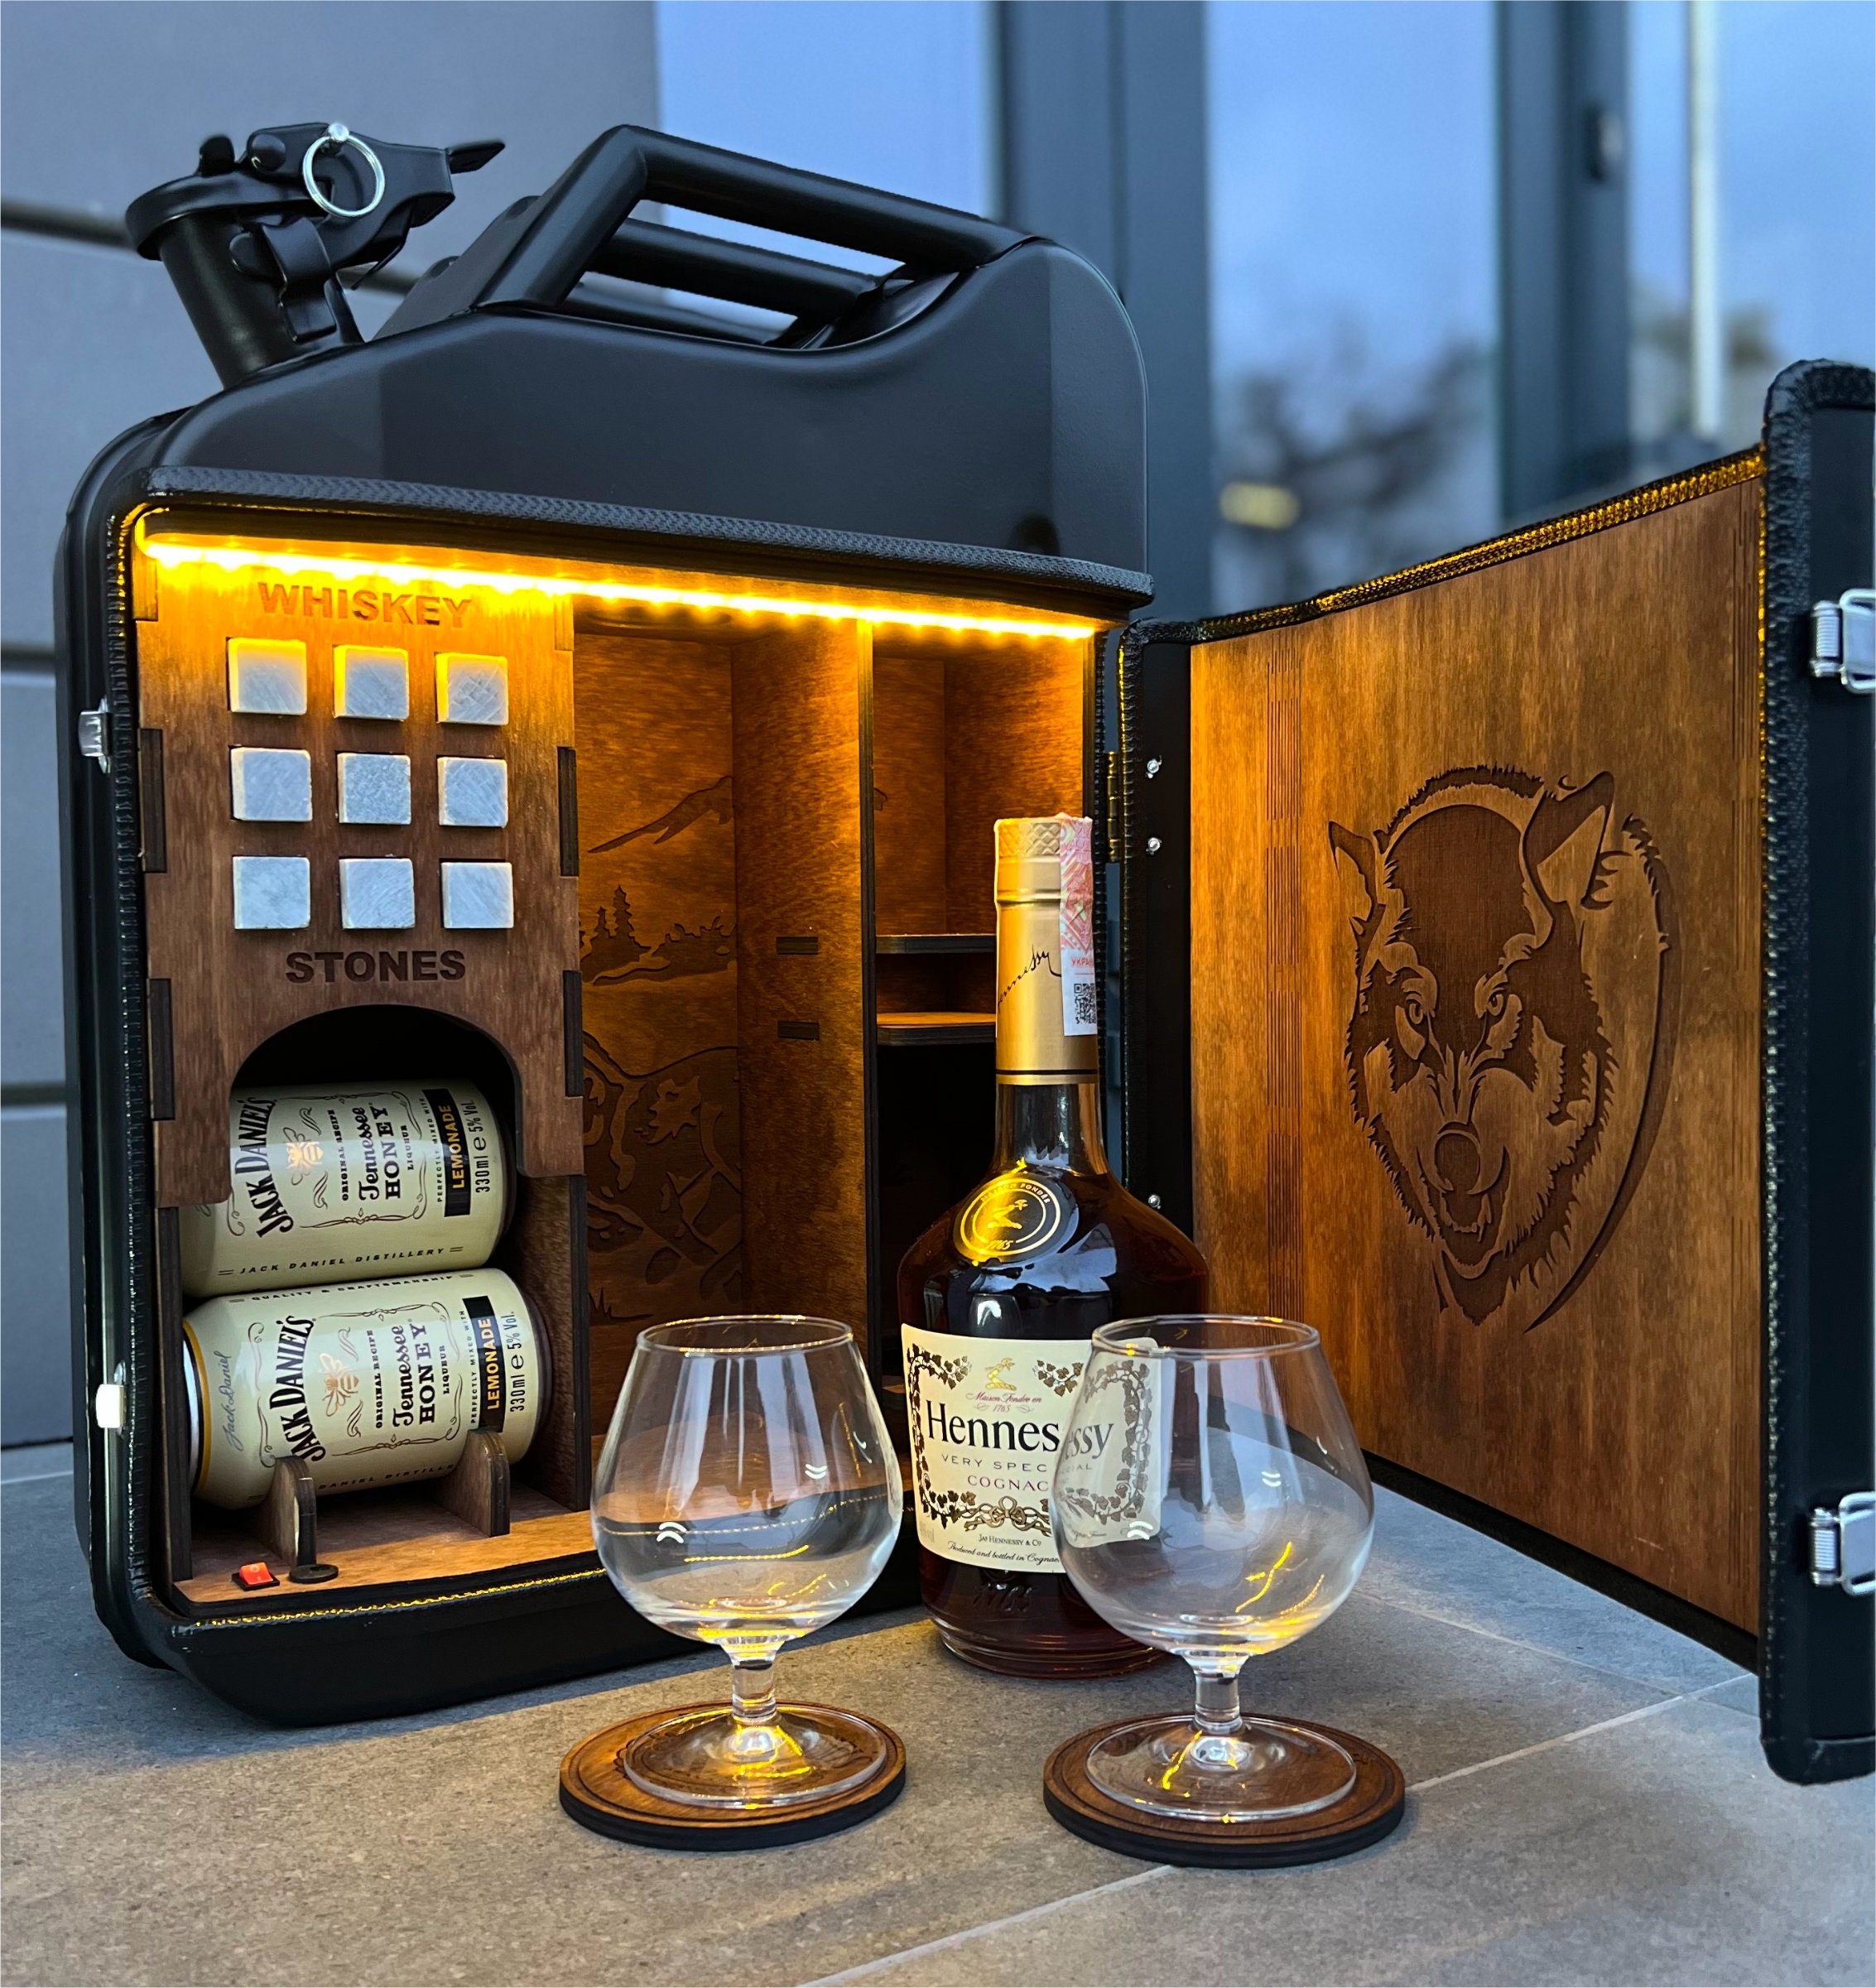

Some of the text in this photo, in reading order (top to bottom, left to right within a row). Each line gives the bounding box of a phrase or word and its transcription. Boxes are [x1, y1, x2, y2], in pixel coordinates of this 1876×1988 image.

[257, 582, 471, 628] WHISKEY
[285, 951, 466, 983] STONES
[427, 1119, 438, 1144] MIXED
[438, 1105, 464, 1189] LEMONADE
[467, 1117, 483, 1133] 5%
[234, 1097, 294, 1238] JACK DANIEL'S
[339, 1147, 349, 1201] ORIGINAL
[352, 1107, 379, 1201] Tennessee
[370, 1106, 401, 1200] HONEY
[474, 1155, 490, 1193] 330ml
[239, 1248, 445, 1274] JACK DANIEL DISTILLERY
[478, 1317, 500, 1410] LEMONADE
[507, 1332, 522, 1350] 5%
[269, 1315, 326, 1461] JACK DANIEL'S
[367, 1330, 383, 1428] ORIGINAL RECIPE
[392, 1325, 414, 1427] Tennessee
[410, 1323, 435, 1424] HONEY
[439, 1345, 450, 1394] LIQUEUR
[459, 1311, 479, 1423] PERFECTLY MIXED WITH
[510, 1374, 526, 1413] 330ml
[993, 1404, 1012, 1413] 1765
[941, 1454, 983, 1467] VERY
[967, 1475, 1049, 1491] COGNAC
[947, 1541, 976, 1555] Produced
[977, 1549, 992, 1557] and
[992, 1551, 1015, 1561] bottled
